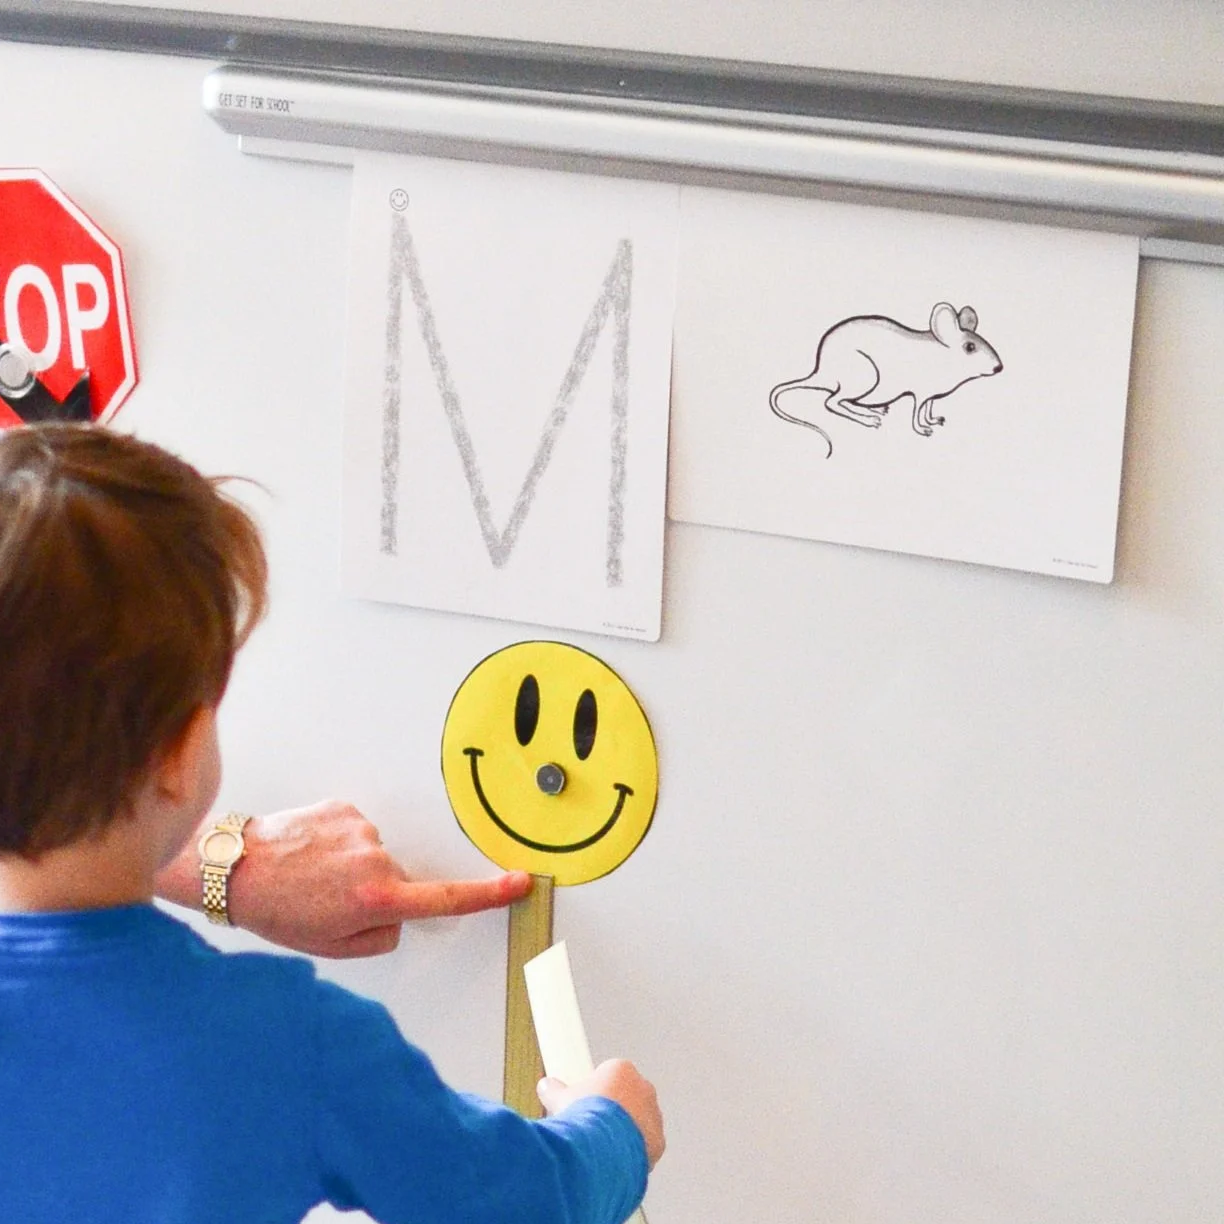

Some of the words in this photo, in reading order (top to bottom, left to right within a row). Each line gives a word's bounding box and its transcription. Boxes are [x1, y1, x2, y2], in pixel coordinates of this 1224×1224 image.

[218, 92, 233, 107] GET
[235, 94, 248, 108] SET
[250, 95, 264, 110] FOR
[380, 212, 633, 588] M
